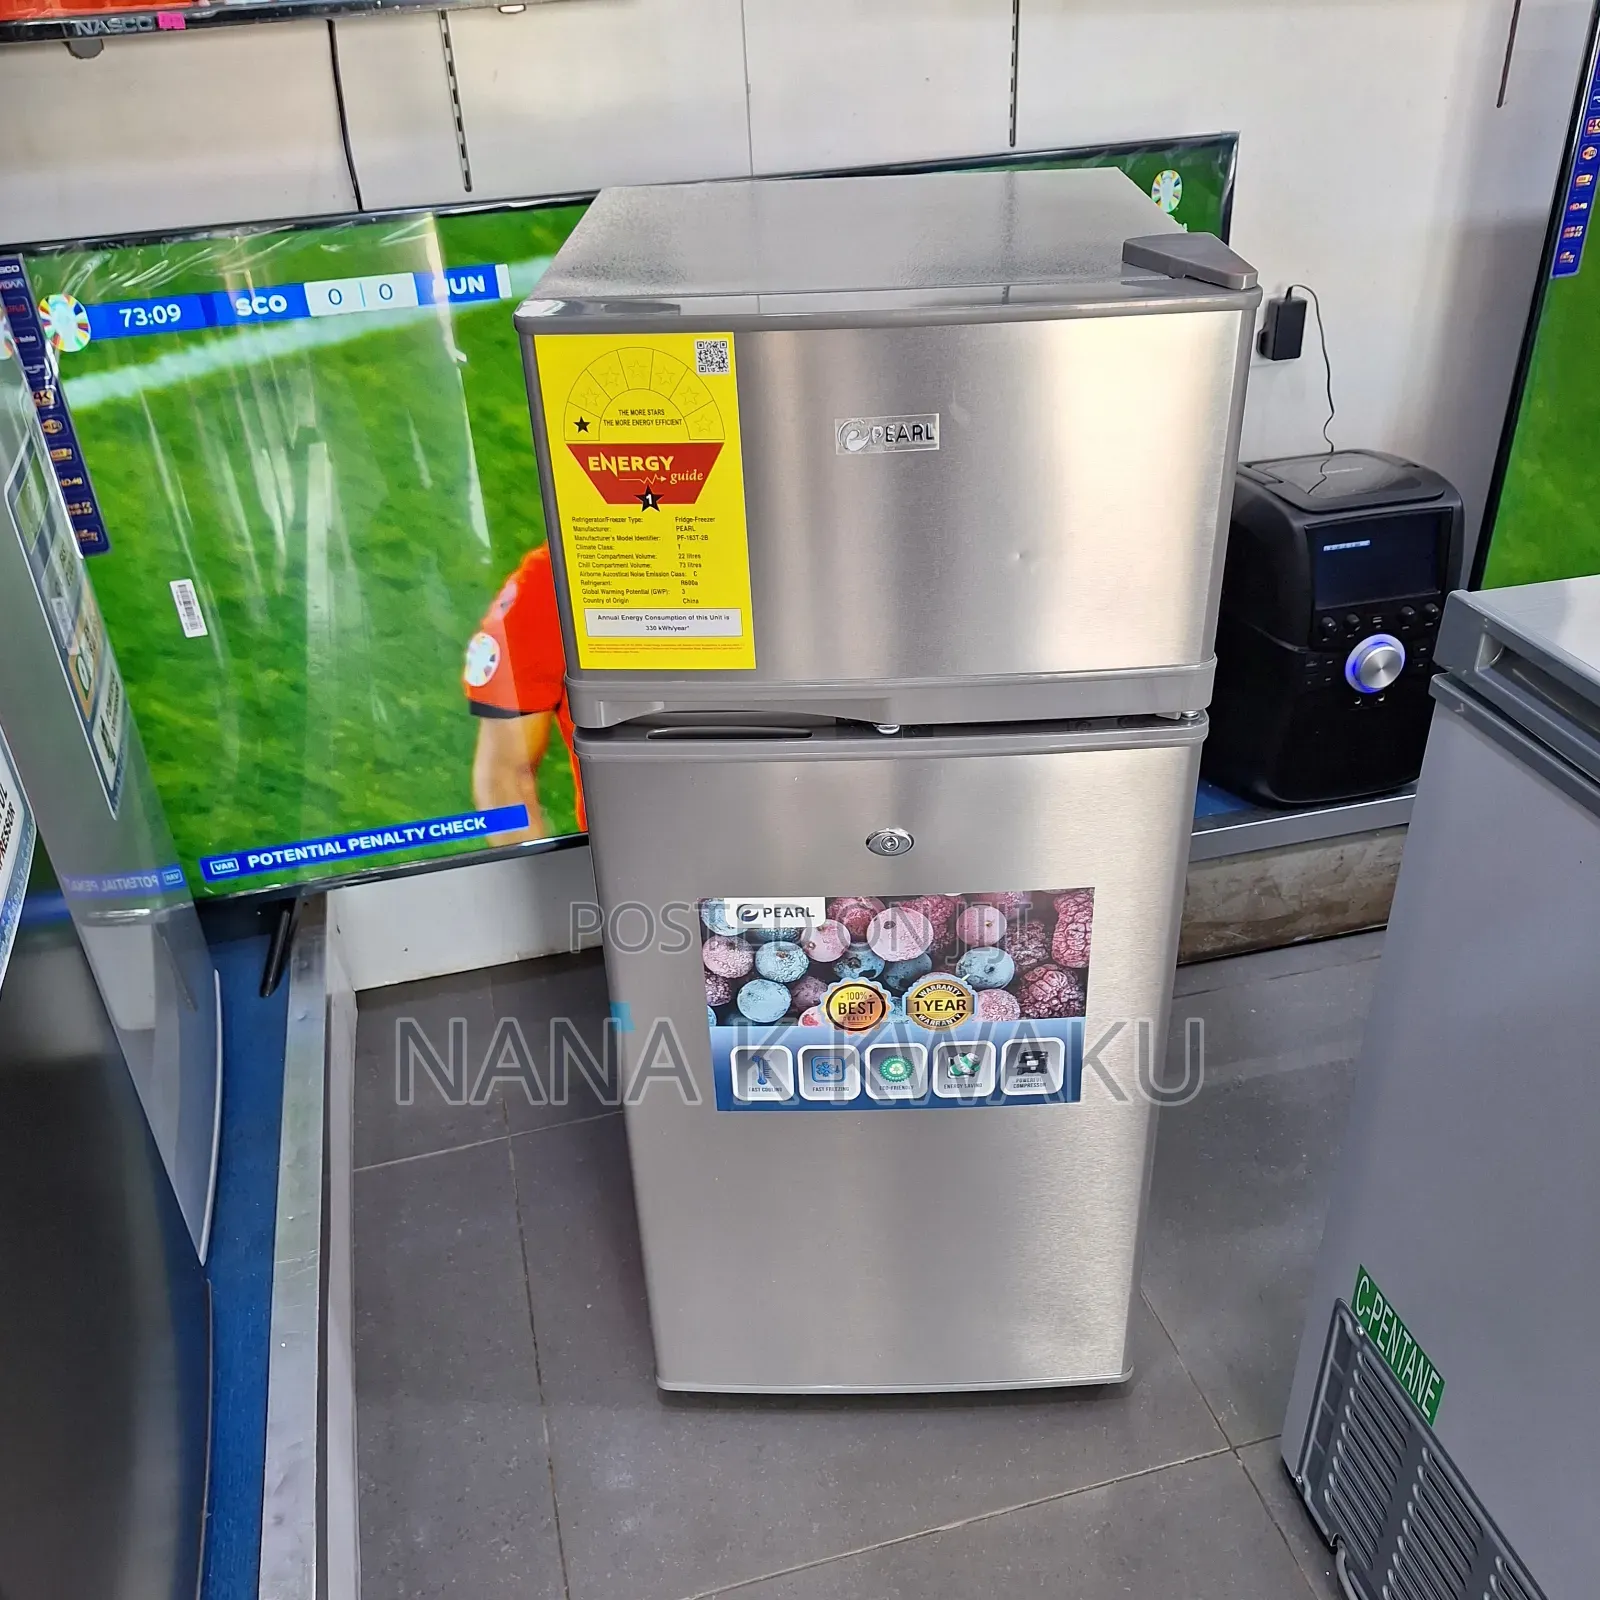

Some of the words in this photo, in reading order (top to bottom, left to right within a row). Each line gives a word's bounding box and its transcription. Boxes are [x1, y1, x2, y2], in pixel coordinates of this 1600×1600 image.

[74, 16, 153, 36] NASCO
[119, 303, 182, 328] 73:09
[234, 294, 288, 317] SCO
[327, 288, 343, 306] 0
[378, 283, 394, 301] 0
[647, 408, 665, 416] STARS
[655, 418, 682, 426] EFFICIENT
[871, 423, 935, 443] PEARL
[587, 451, 675, 477] ENERGY
[669, 469, 704, 485] guide
[645, 493, 652, 505] 1
[628, 516, 643, 525] Type:
[675, 516, 715, 524] Fridge-Freezer
[600, 588, 624, 596] Warming
[612, 597, 629, 605] Origin
[620, 614, 644, 622] Energy
[644, 614, 687, 622] Consumption
[215, 861, 236, 871] VAR
[248, 841, 347, 868] POTENTIAL
[347, 826, 426, 851] PENALTY
[429, 816, 487, 837] CHECK
[763, 906, 816, 918] PEARL
[845, 991, 868, 1000] 100%
[918, 983, 963, 998] WARRANTY
[838, 1001, 876, 1015] BEST
[913, 1001, 920, 1012] 1
[923, 999, 967, 1012] YEAR
[918, 1013, 962, 1027] WARRANTY
[1356, 1275, 1441, 1419] C-PENTANE
